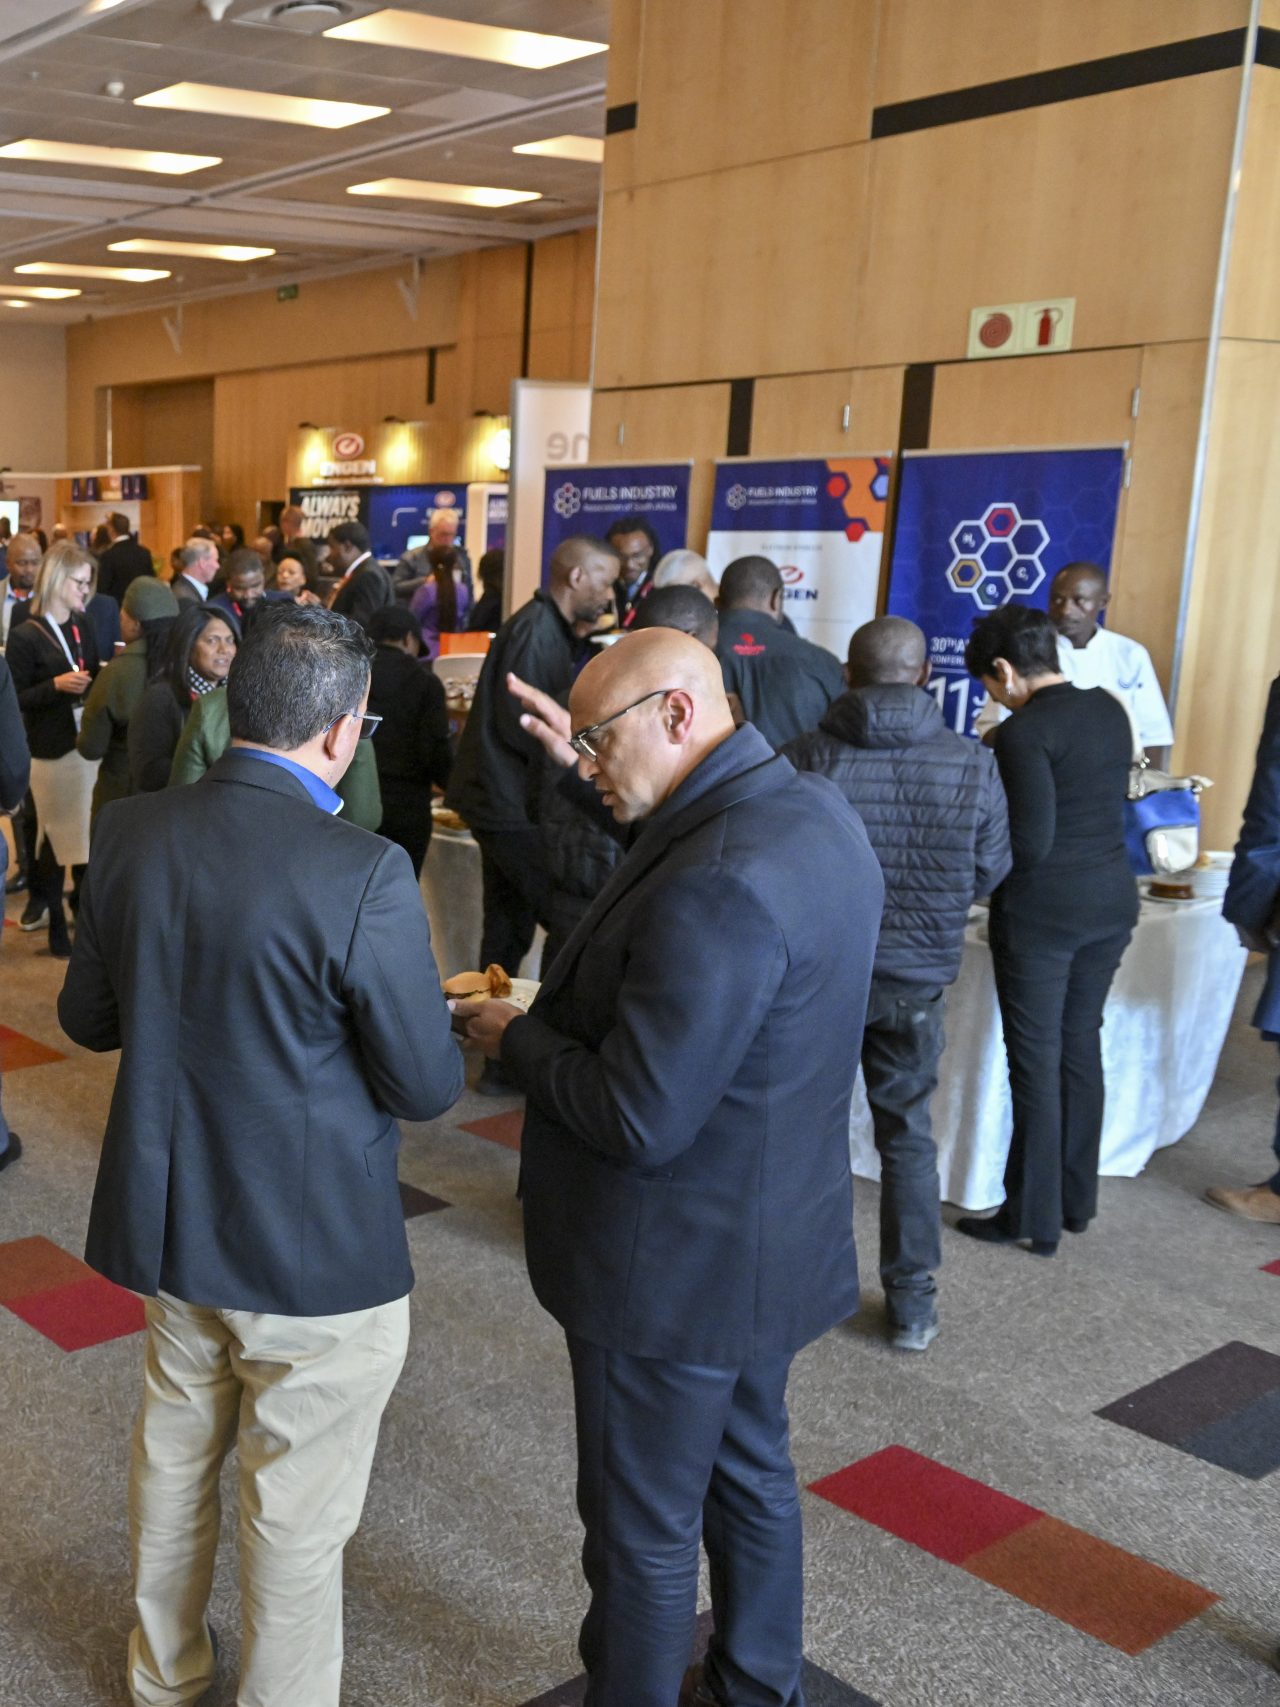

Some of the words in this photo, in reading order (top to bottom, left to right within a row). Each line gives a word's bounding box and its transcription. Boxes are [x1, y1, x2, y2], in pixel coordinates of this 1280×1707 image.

[582, 487, 618, 501] FUELS
[620, 485, 678, 500] INDUSTRY
[927, 676, 970, 735] 11
